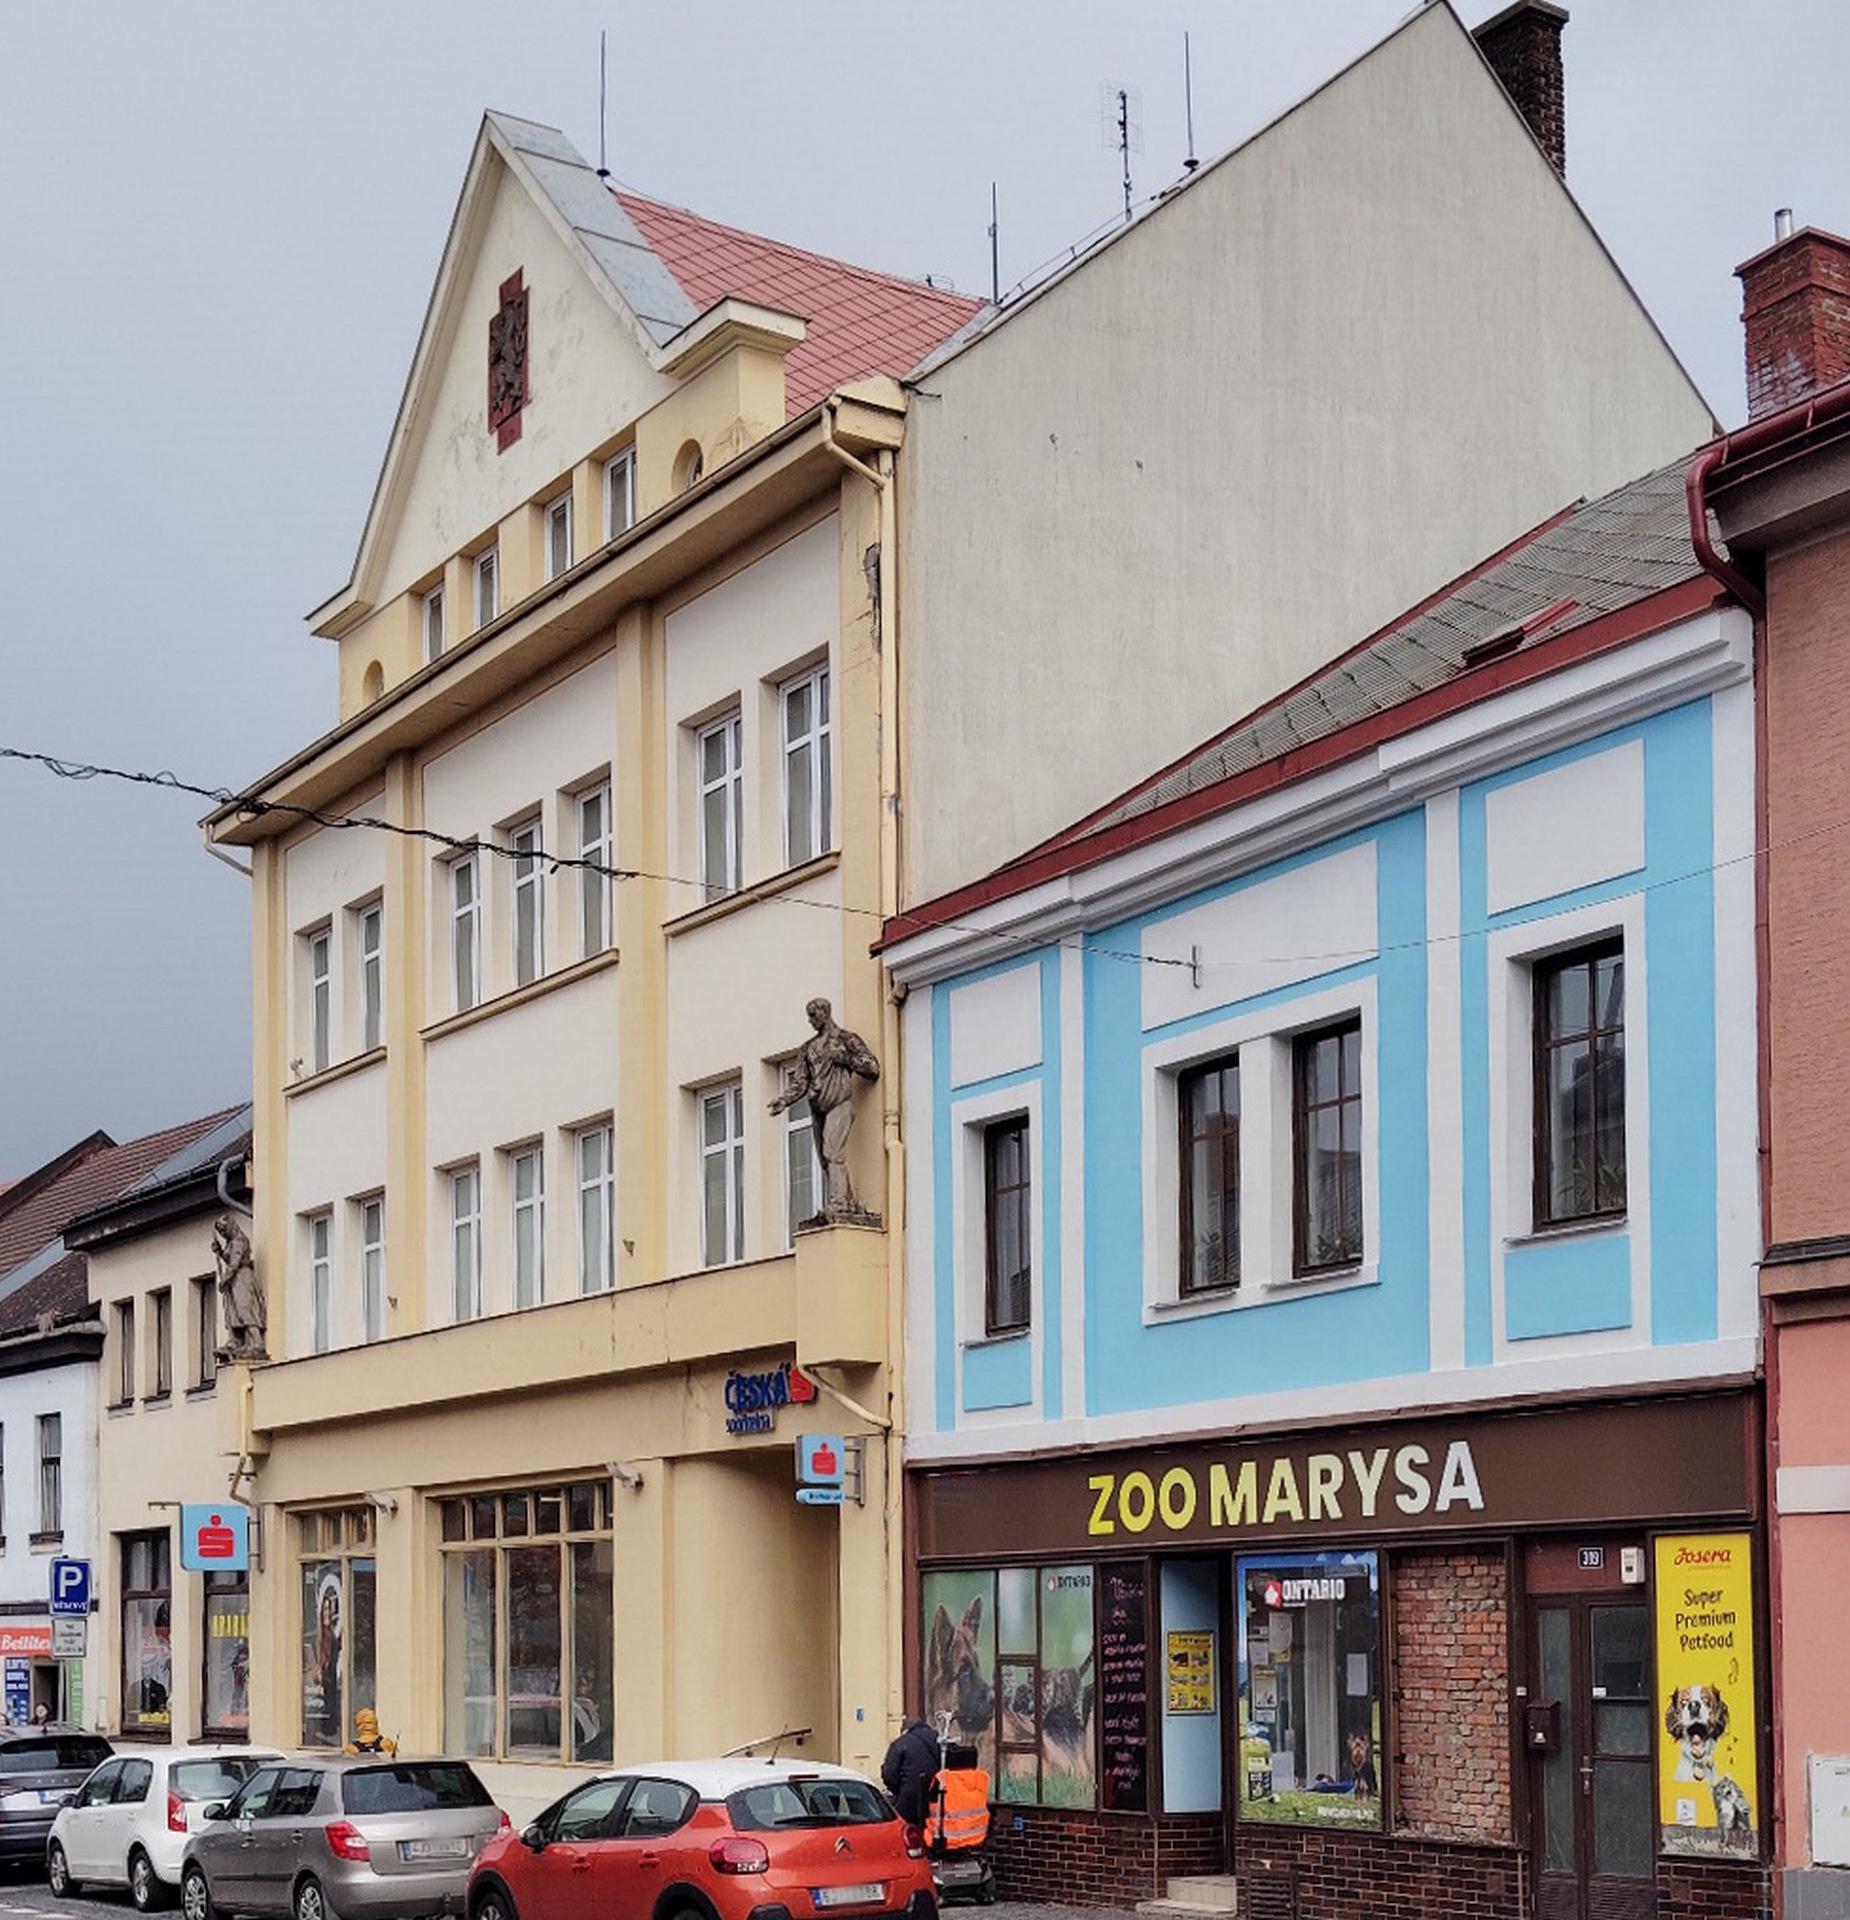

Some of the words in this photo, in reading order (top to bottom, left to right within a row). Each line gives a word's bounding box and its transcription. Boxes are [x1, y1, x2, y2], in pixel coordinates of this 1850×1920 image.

[725, 1361, 791, 1412] ČESKÁ
[1088, 1467, 1196, 1536] ZOO
[1210, 1441, 1484, 1527] MARYSA
[1674, 1547, 1731, 1566] Josera
[59, 1566, 83, 1598] P
[1282, 1579, 1345, 1600] ONTARIO
[1684, 1588, 1724, 1609] Super
[1675, 1609, 1736, 1631] Premium
[1680, 1631, 1733, 1652] Petfood
